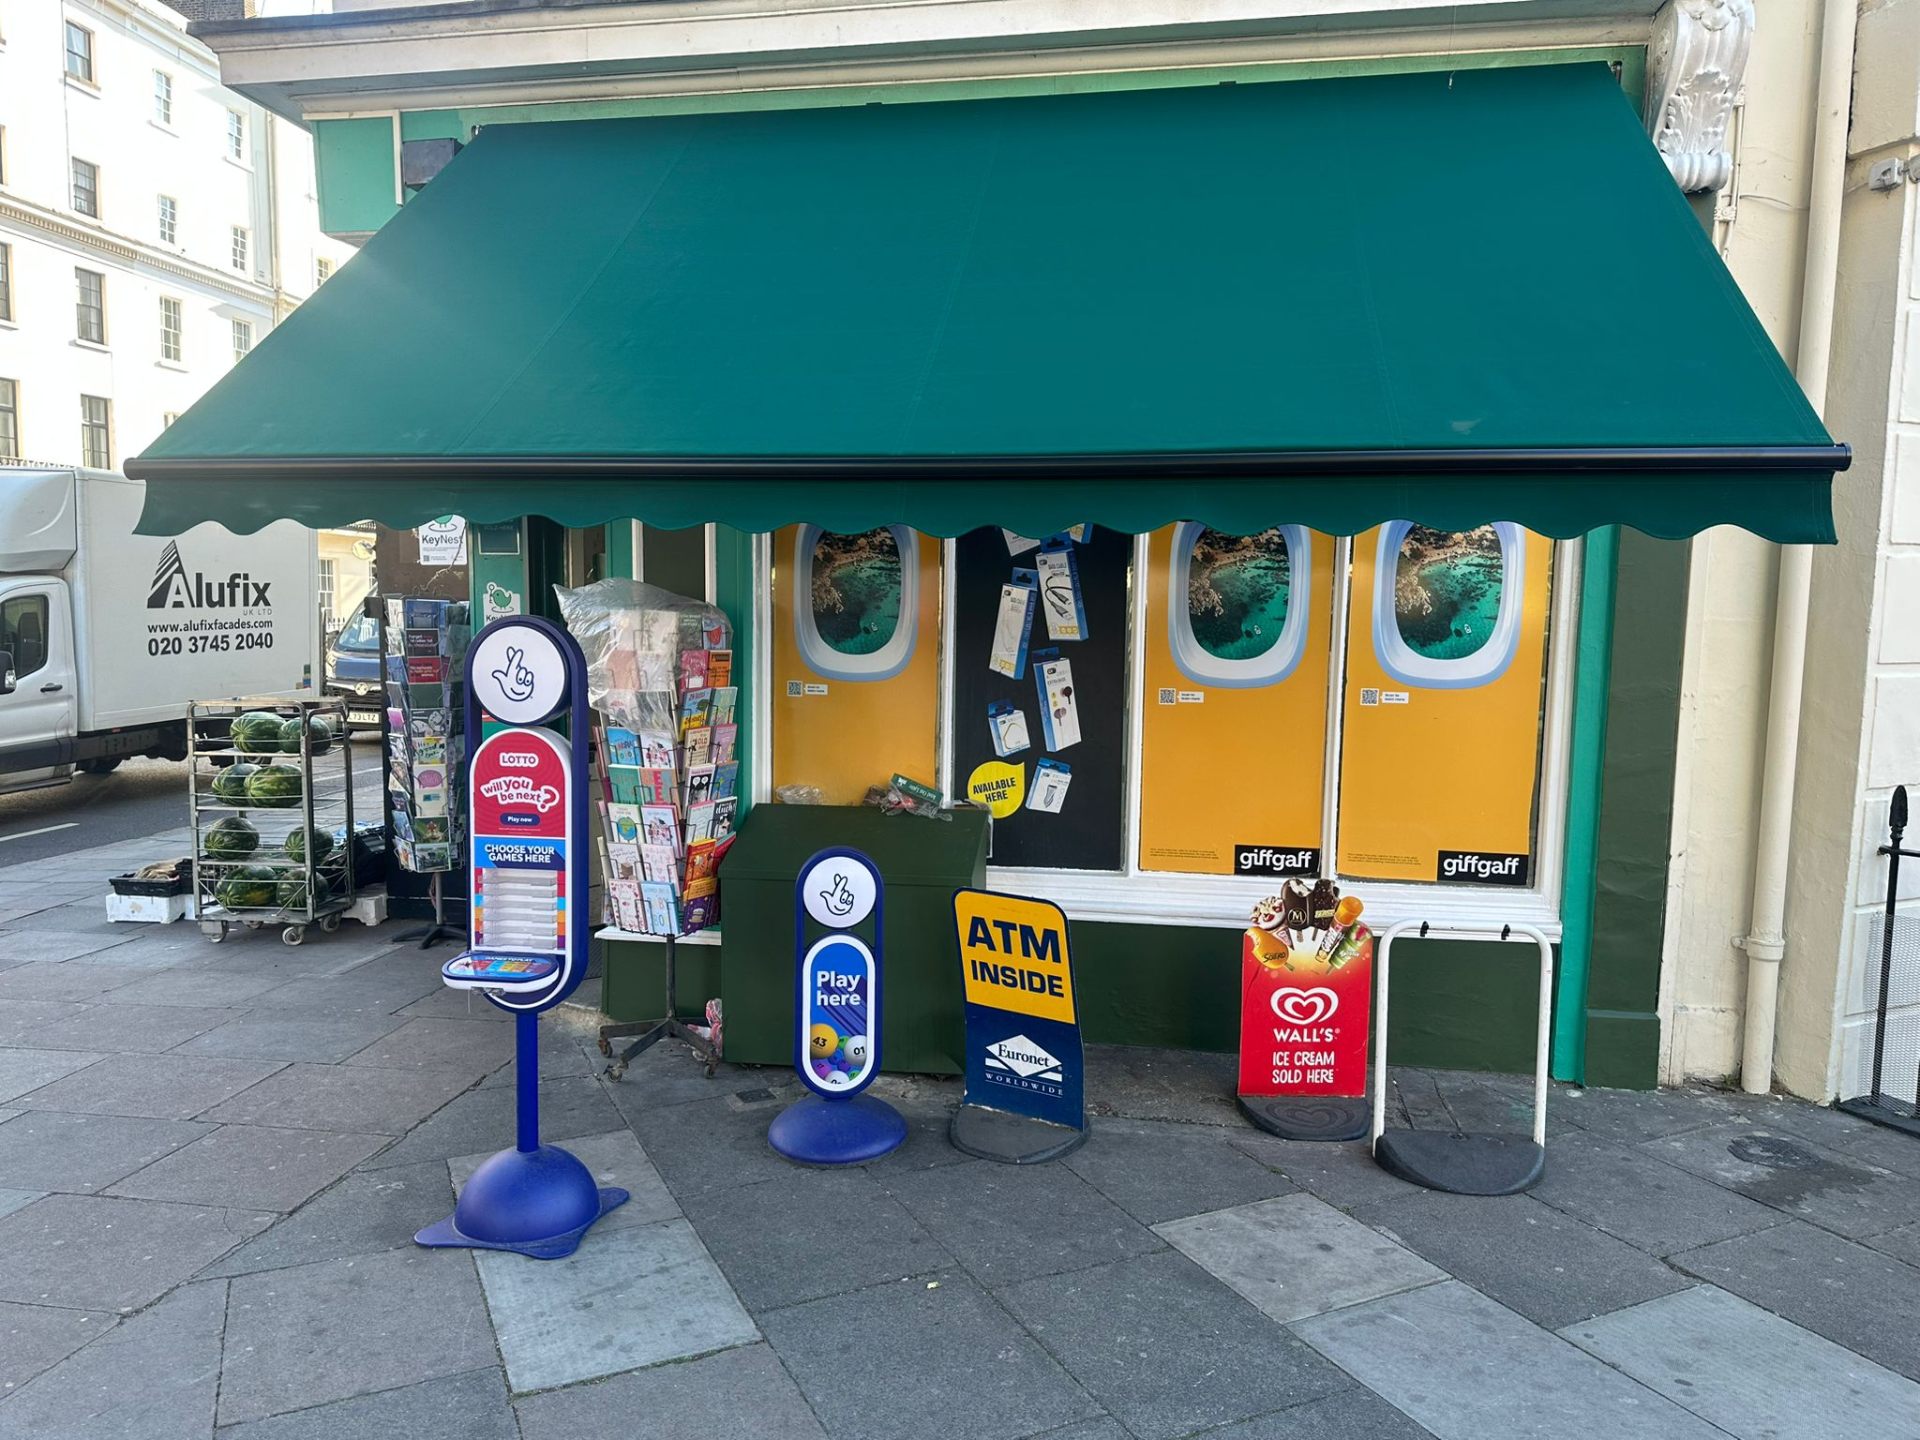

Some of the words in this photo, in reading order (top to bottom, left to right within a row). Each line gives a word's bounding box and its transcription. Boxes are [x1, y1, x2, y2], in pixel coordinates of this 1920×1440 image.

[422, 534, 464, 546] KeyNest
[243, 608, 254, 616] UK
[257, 608, 273, 616] LTD
[147, 618, 273, 633] www.alufixfacades.com
[148, 637, 182, 656] 020
[188, 634, 230, 654] 3745
[235, 632, 273, 651] 2040
[501, 754, 537, 765] LOTTO
[483, 781, 503, 794] will
[503, 778, 530, 792] you
[973, 777, 1017, 794] AVAILABLE
[500, 791, 515, 802] be
[985, 790, 1009, 803] HERE
[507, 815, 520, 824] Play
[484, 843, 527, 855] CHOOSE
[527, 845, 556, 856] YOUR
[488, 852, 524, 862] GAMES
[524, 854, 552, 864] HERE
[1239, 849, 1313, 871] giffgaff
[1443, 854, 1520, 877] giffgaff
[967, 915, 1062, 964] ATM
[816, 970, 861, 991] Play
[971, 959, 1065, 998] INSIDE
[816, 990, 862, 1006] here
[812, 1036, 828, 1048] 43
[1273, 1028, 1334, 1043] WALL'S
[853, 1045, 866, 1056] 01
[997, 1043, 1051, 1068] Euronet
[1272, 1051, 1290, 1067] ICE
[1294, 1050, 1335, 1067] CREAM
[985, 1072, 1064, 1096] WORLDWIDE
[1271, 1068, 1303, 1084] SOLD
[1306, 1068, 1334, 1084] HERE
